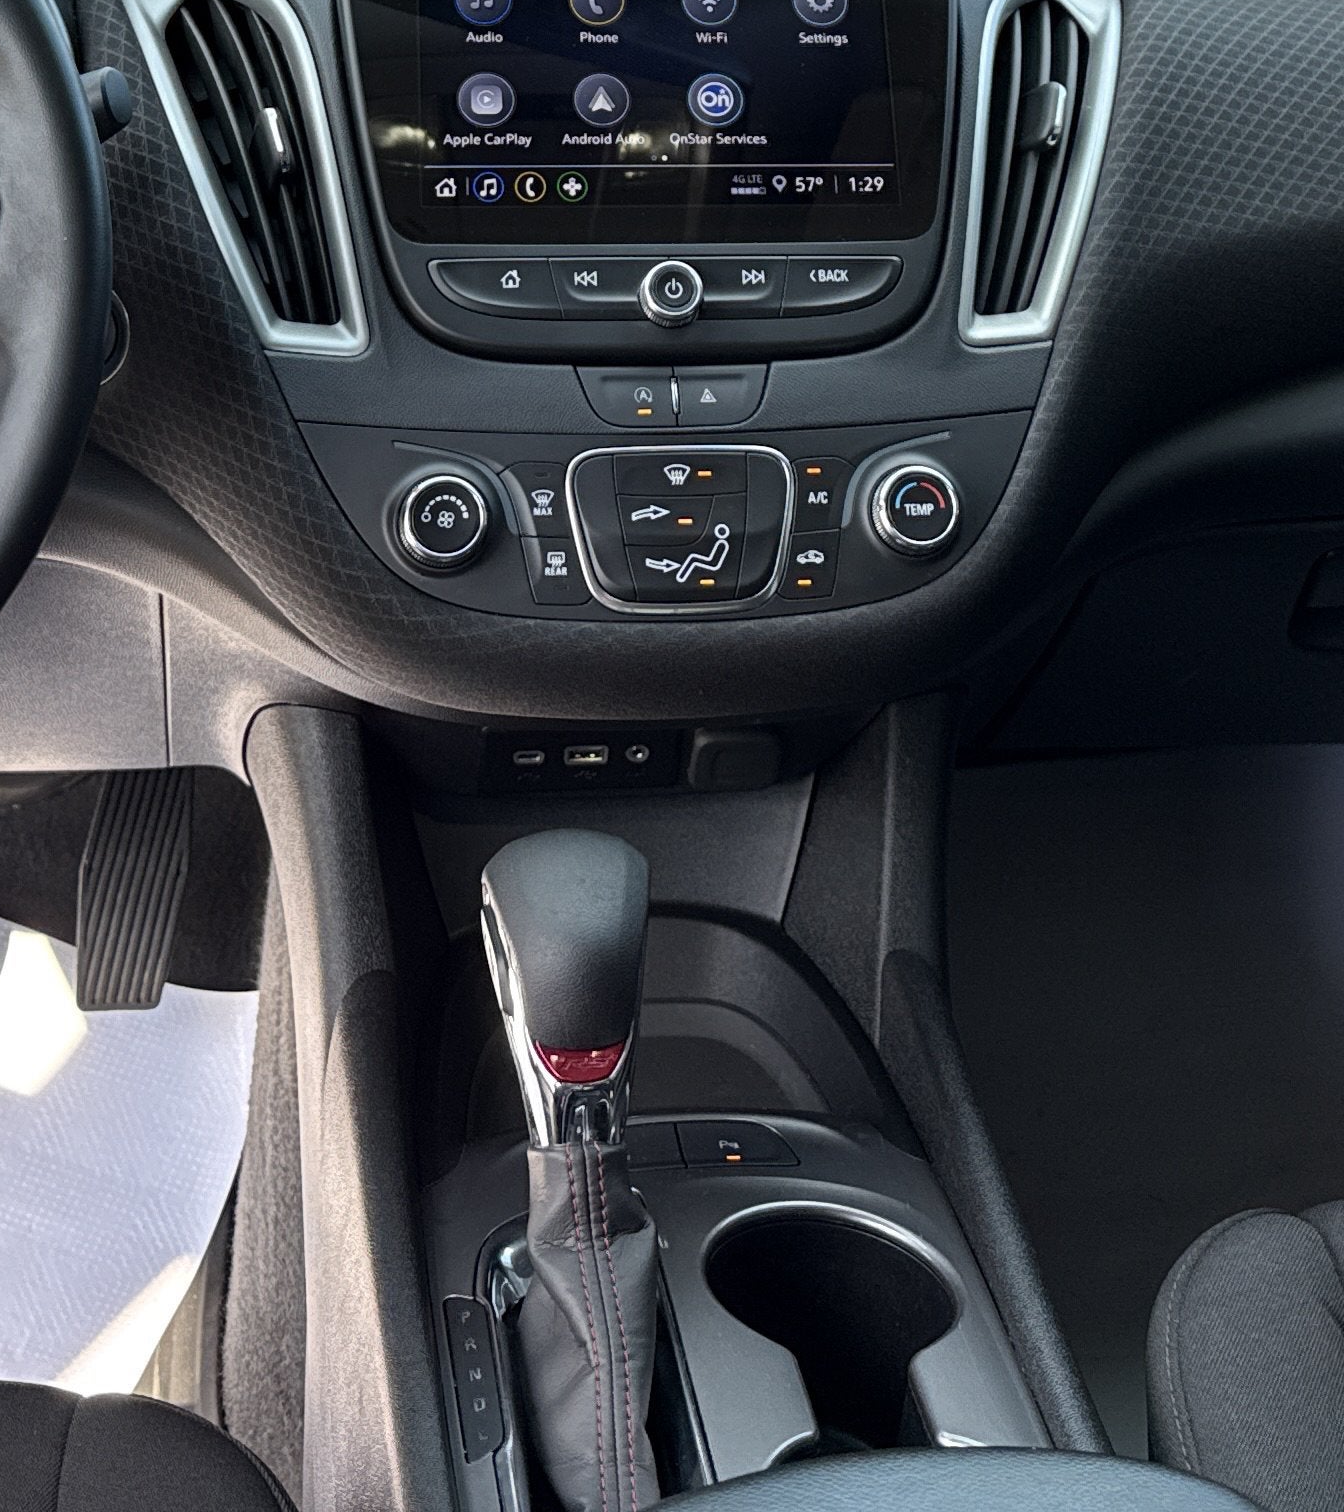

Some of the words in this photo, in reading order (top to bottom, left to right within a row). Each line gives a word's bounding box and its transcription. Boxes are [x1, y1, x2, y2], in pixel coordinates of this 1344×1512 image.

[465, 31, 504, 43] Audio
[579, 31, 619, 43] Phone
[695, 31, 729, 44] Wi-Fi
[798, 31, 849, 47] Settings
[442, 133, 482, 148] Apple
[484, 133, 533, 148] CarPlay
[561, 133, 613, 145] Android
[614, 133, 646, 146] Auto
[669, 132, 713, 145] OnStar
[716, 132, 768, 145] Services
[732, 174, 746, 184] 4G
[747, 174, 764, 184] LTE
[848, 176, 885, 192] 1:29
[818, 268, 850, 283] BACK
[808, 491, 829, 504] A/C
[532, 507, 553, 516] MAX
[904, 502, 935, 517] TEMP
[544, 566, 568, 576] REAR
[461, 1311, 471, 1324] P
[464, 1337, 477, 1352] R
[469, 1367, 482, 1382] N
[473, 1397, 487, 1413] D
